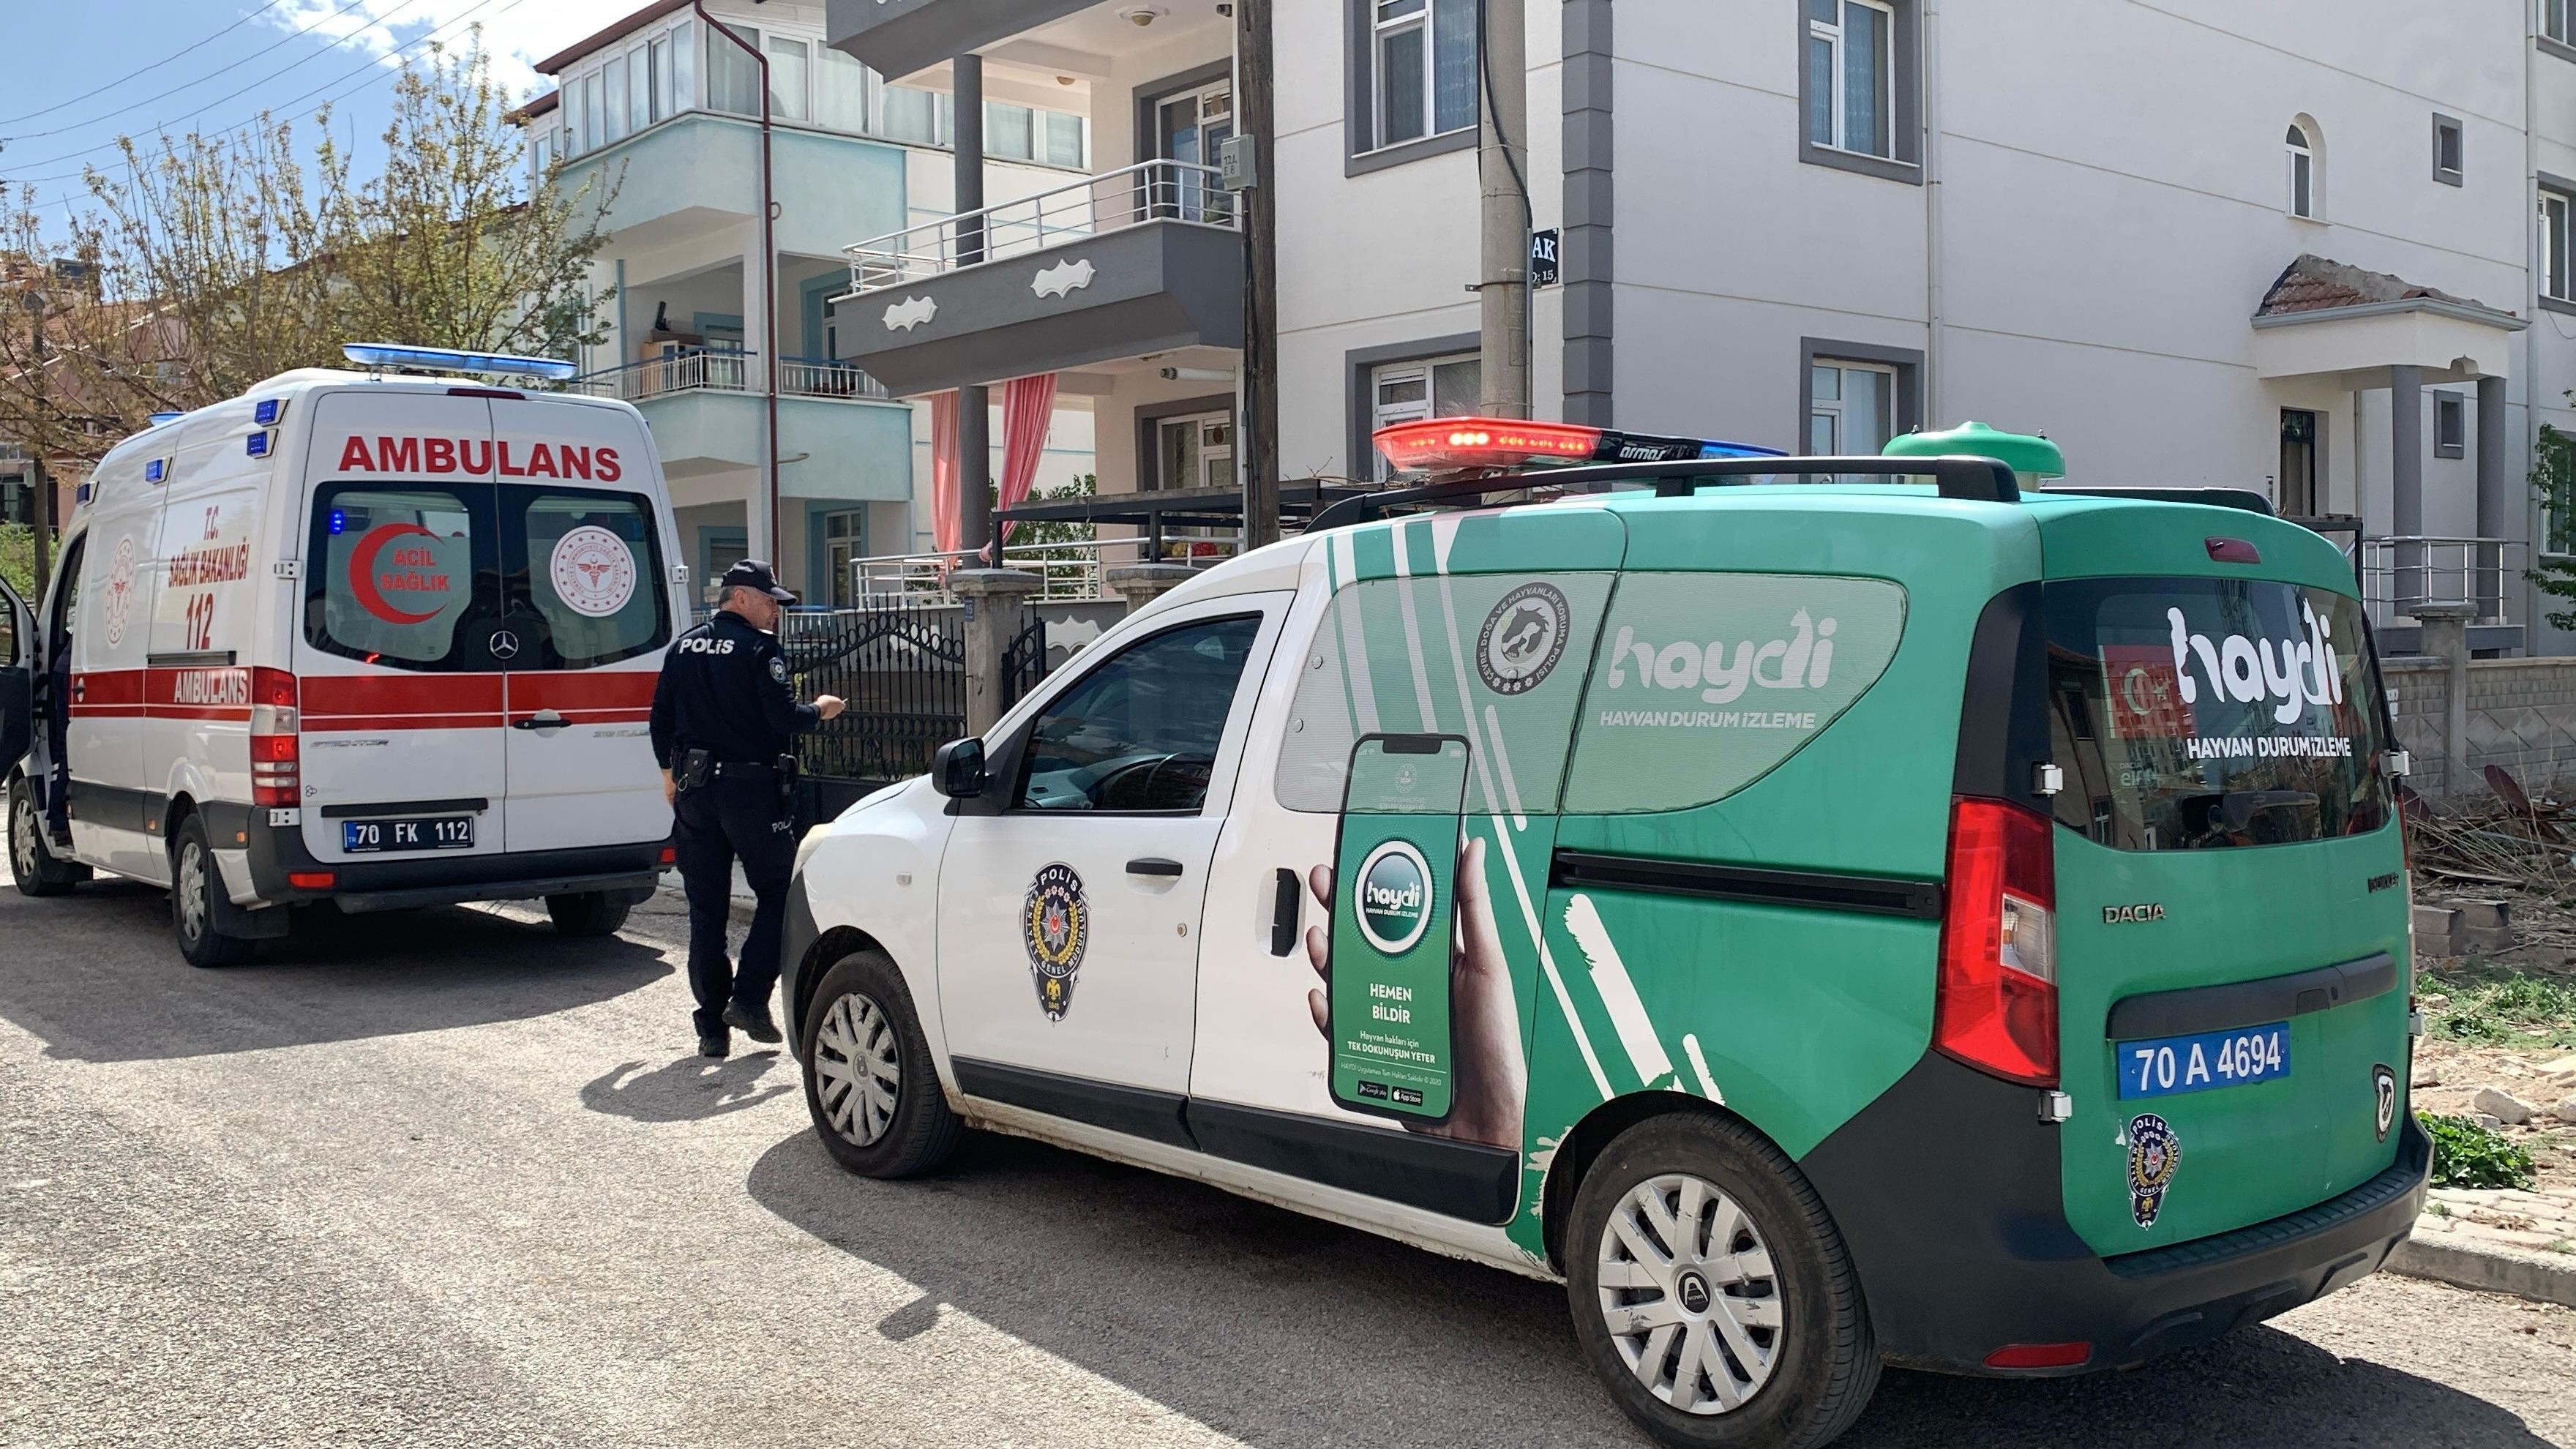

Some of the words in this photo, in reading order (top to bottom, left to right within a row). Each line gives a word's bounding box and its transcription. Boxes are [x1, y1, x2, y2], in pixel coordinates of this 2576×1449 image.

[1532, 236, 1556, 263] AK
[1543, 269, 1554, 281] 15
[338, 435, 621, 482] AMBULANS
[1619, 446, 1666, 460] armas
[203, 506, 219, 540] T.C.
[168, 546, 199, 588] SAĞLIK
[199, 536, 250, 585] BAKANLIĞI
[393, 546, 436, 566] ACİL
[381, 572, 450, 592] SAĞLIK
[187, 593, 213, 650] 112
[1481, 617, 1497, 647] DOĞA
[1496, 602, 1509, 615] VE
[1508, 586, 1560, 604] HAYVANLARI
[1556, 602, 1567, 645] KORUMA
[678, 637, 735, 654] POLİS
[1608, 606, 1838, 704] haydi
[2167, 597, 2342, 724] haydi
[174, 669, 247, 704] AMBULANS
[1600, 711, 1669, 727] HAYVAN
[1669, 711, 1740, 728] DURUM
[1742, 711, 1816, 729] İZLEME
[2187, 736, 2253, 759] HAYVAN
[2257, 736, 2311, 757] DURUM
[2311, 736, 2352, 757] İZLEME
[356, 824, 380, 845] 70
[394, 823, 418, 843] FK
[435, 821, 468, 841] 112
[1041, 869, 1078, 892] POLİS
[1366, 881, 1421, 910] haydi
[2104, 903, 2166, 924] DACIA
[1370, 983, 1412, 1002] HEMEN
[1372, 1002, 1410, 1024] BİLDİR
[1360, 1030, 1384, 1043] Hayvan
[1385, 1033, 1407, 1046] hakları
[1407, 1038, 1419, 1049] için
[1347, 1041, 1361, 1052] TEK
[1362, 1043, 1410, 1060] DOKUNUŞUN
[1411, 1052, 1436, 1064] YETER
[2135, 1046, 2176, 1091] 70
[2185, 1043, 2210, 1085] A
[2217, 1032, 2281, 1079] 4694
[1400, 1093, 1409, 1101] App
[1409, 1095, 1421, 1104] Store
[2133, 1117, 2163, 1135] POLİS
